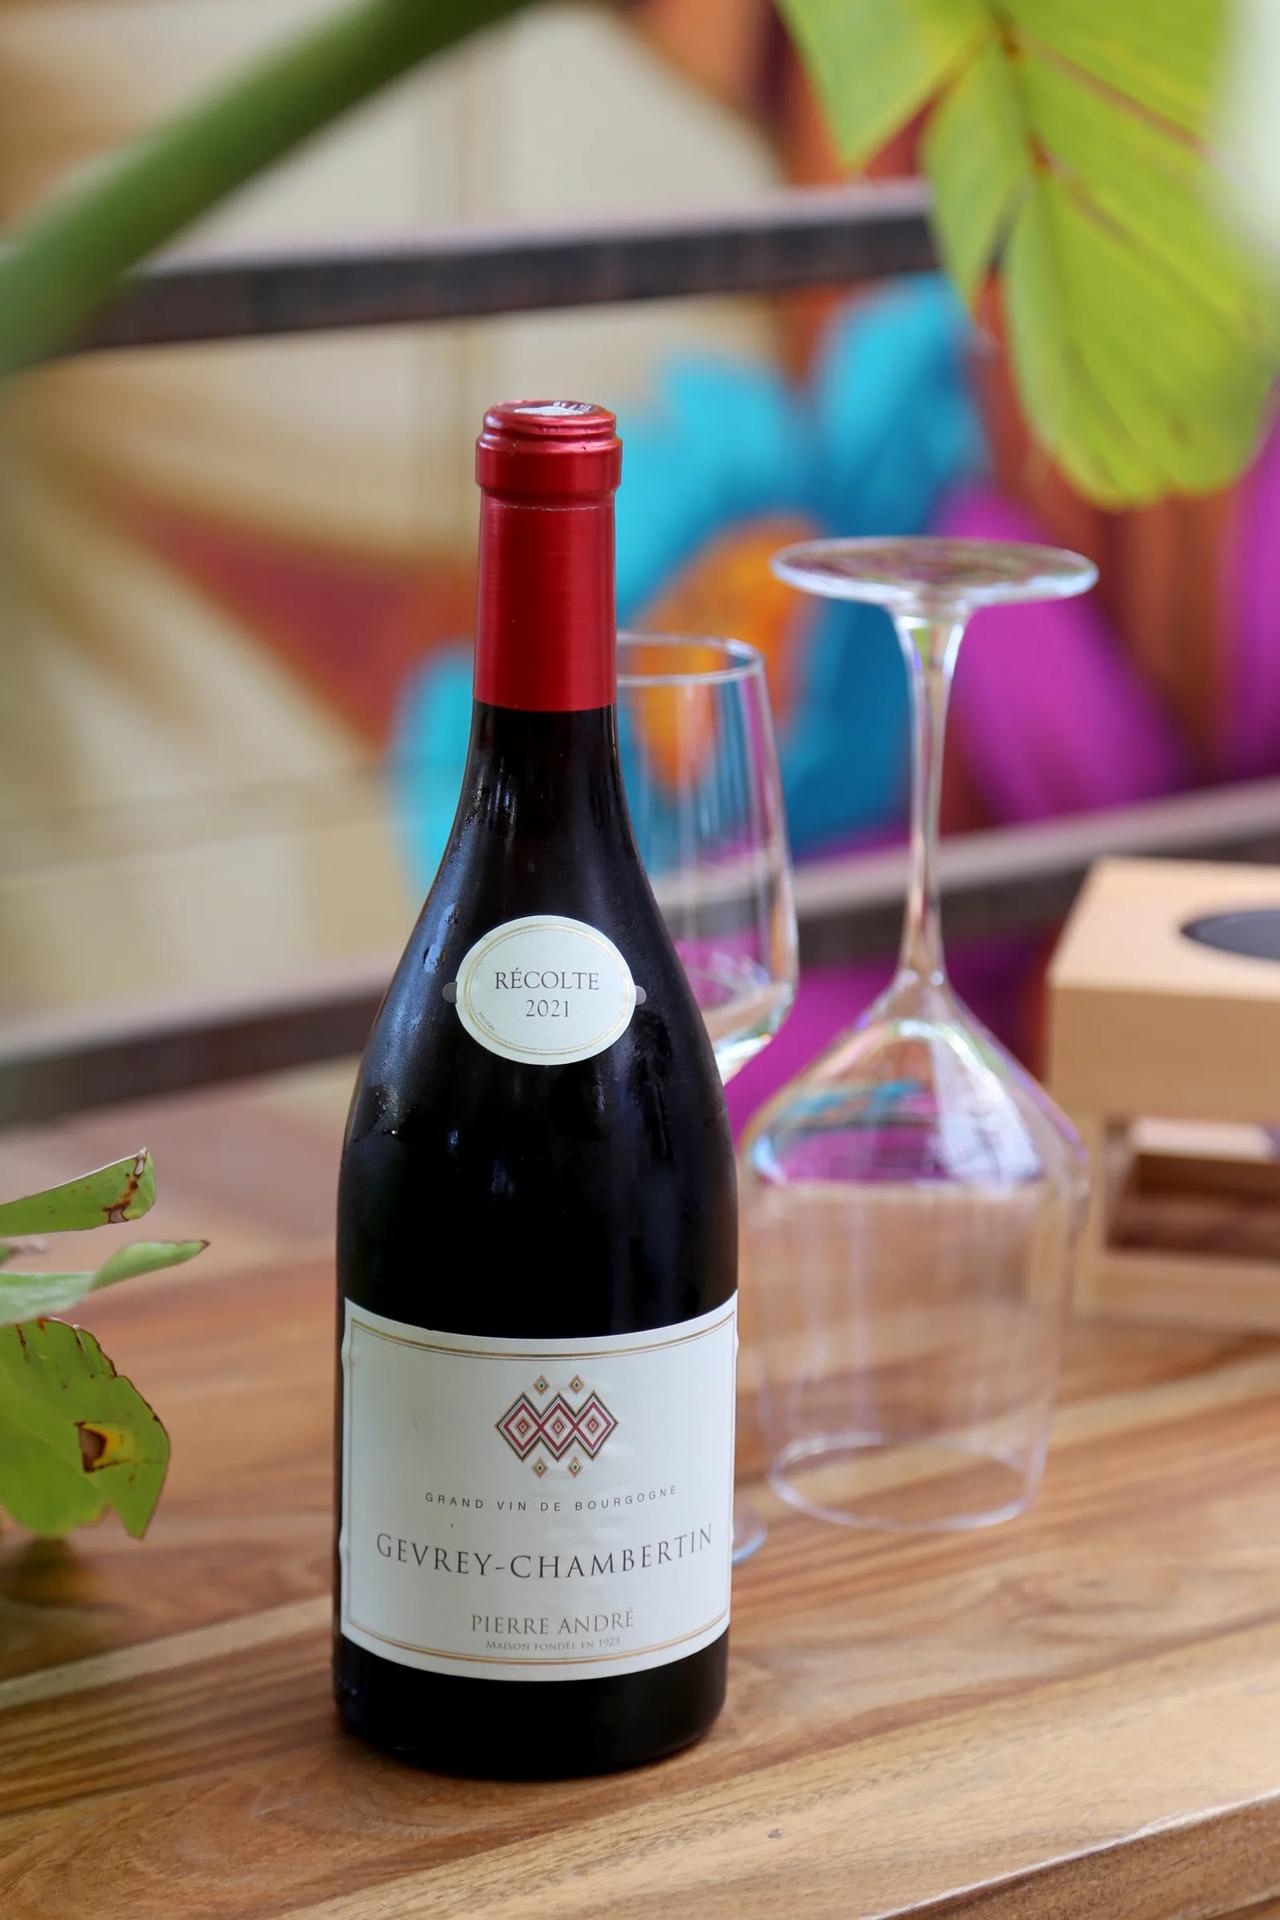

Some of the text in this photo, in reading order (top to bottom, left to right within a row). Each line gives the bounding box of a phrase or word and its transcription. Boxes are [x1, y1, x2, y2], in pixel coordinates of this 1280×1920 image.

[495, 967, 600, 990] RÉCOLTE
[525, 999, 570, 1018] 2021
[425, 1485, 678, 1512] GRAND VIN DE BOURGOGNE
[376, 1523, 713, 1579] GEVREY-CHAMBERTIN
[472, 1607, 634, 1635] PIERRE ANDRÉ
[581, 1639, 594, 1649] EN
